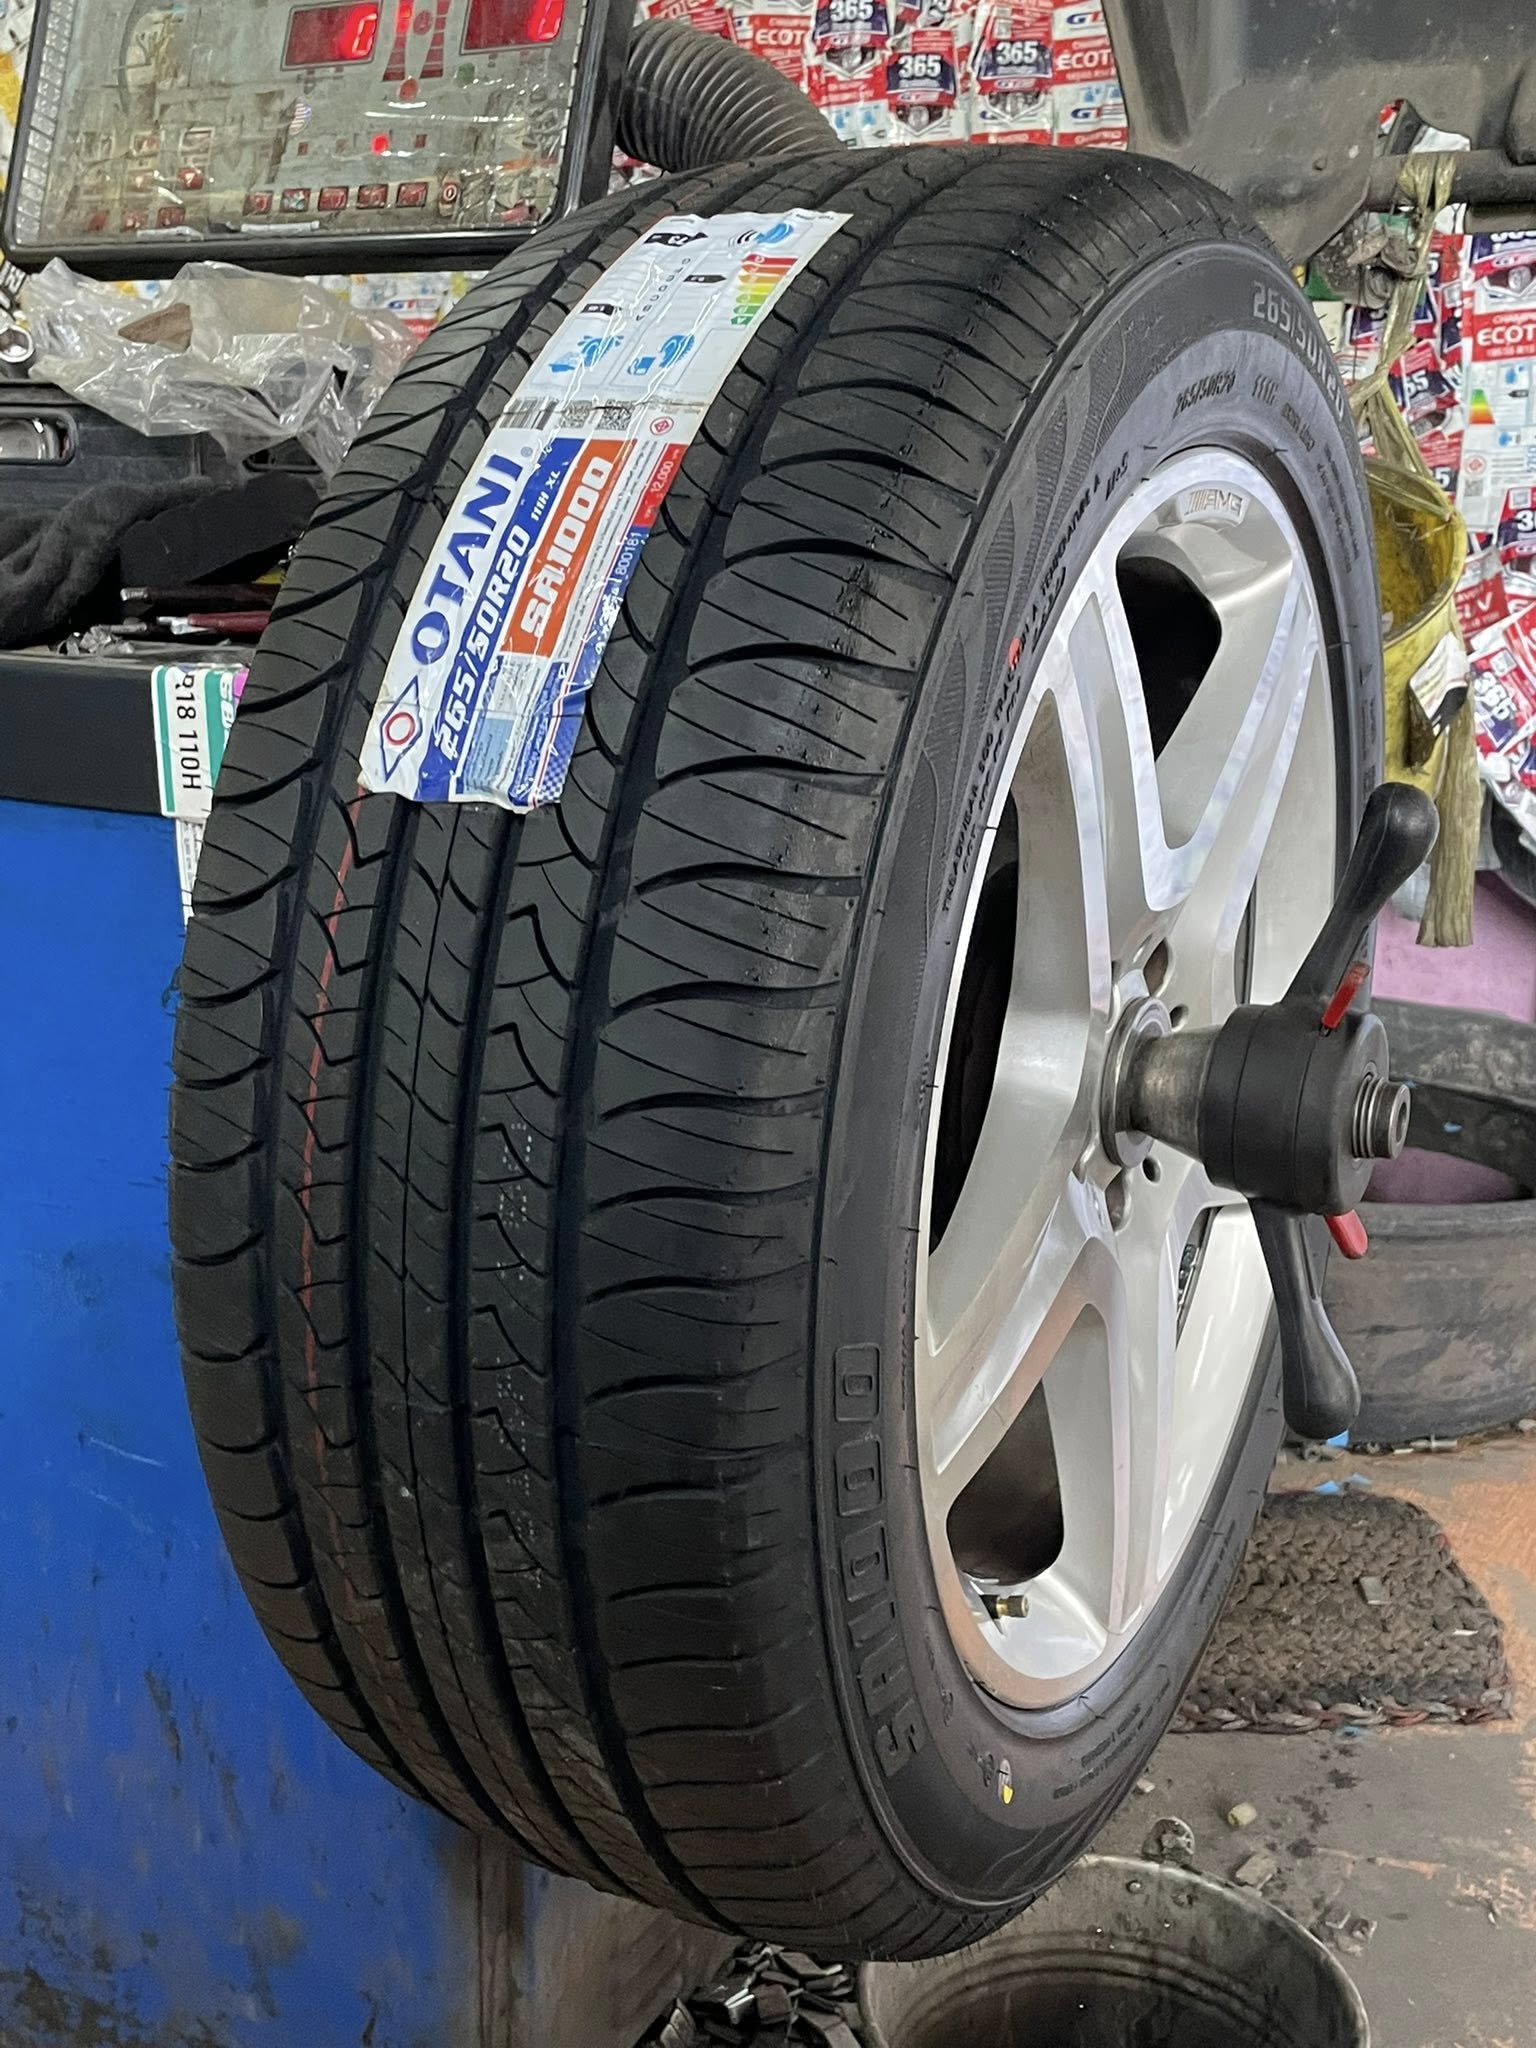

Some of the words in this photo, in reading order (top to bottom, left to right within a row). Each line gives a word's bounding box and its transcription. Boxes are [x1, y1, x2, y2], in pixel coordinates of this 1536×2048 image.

[829, 0, 873, 22] 365
[899, 54, 942, 77] 365
[996, 41, 1038, 65] 365
[1200, 488, 1243, 517] AMG
[412, 454, 523, 665] OTANI
[520, 456, 613, 638] SA1000
[616, 532, 642, 575] 800181
[433, 524, 531, 760] 265/50R20
[531, 492, 550, 521] 111H
[546, 470, 560, 489] XL
[179, 731, 202, 789] 110H
